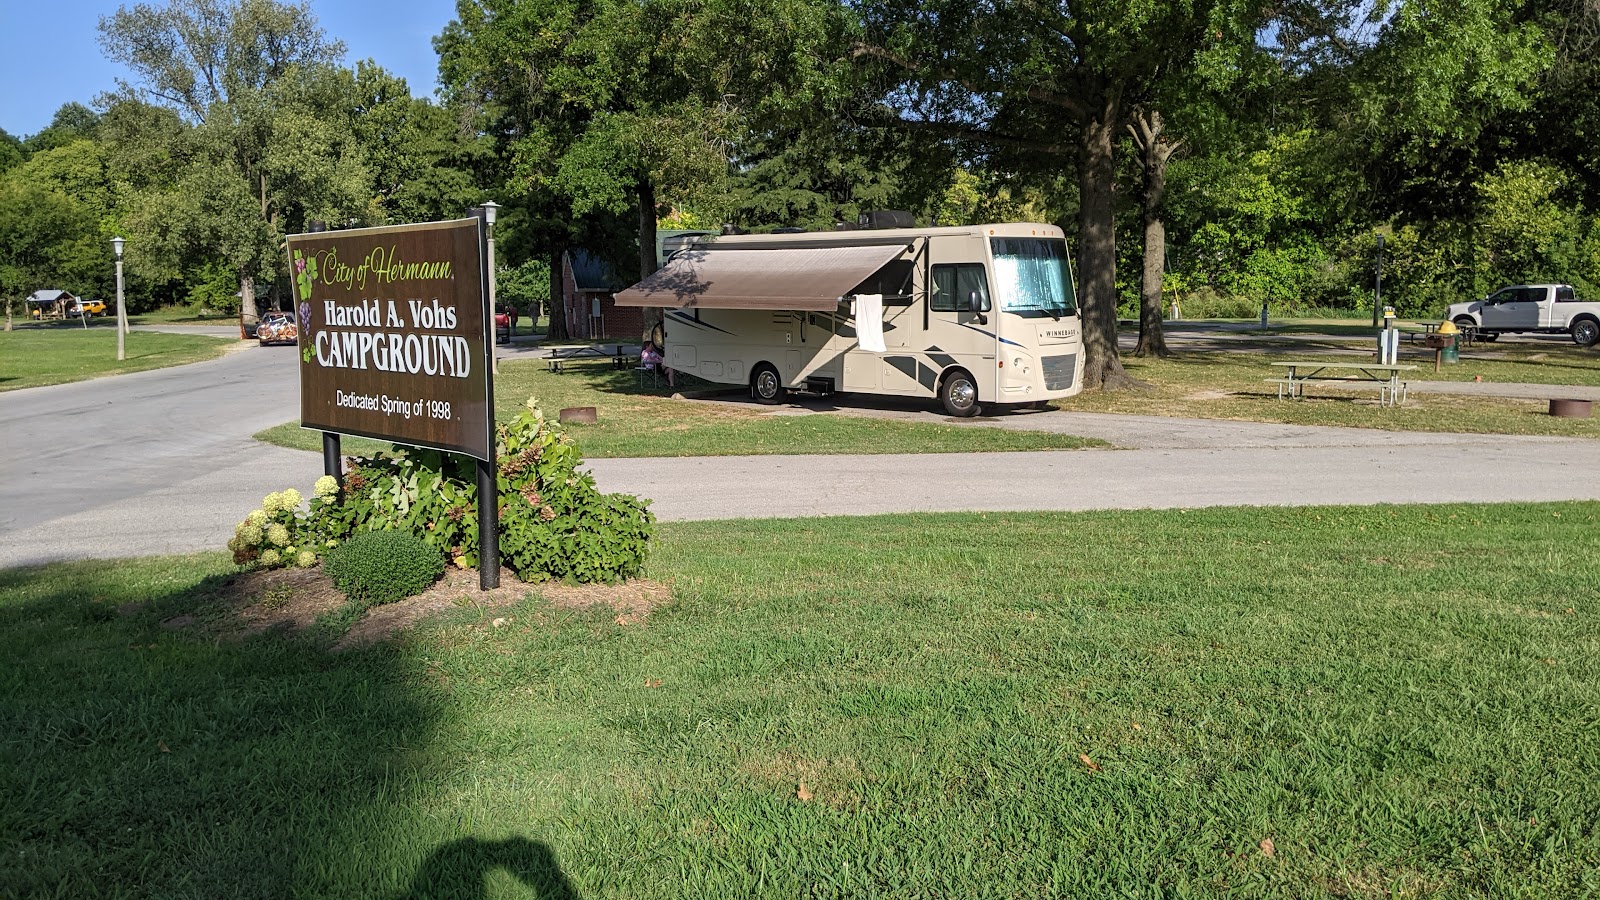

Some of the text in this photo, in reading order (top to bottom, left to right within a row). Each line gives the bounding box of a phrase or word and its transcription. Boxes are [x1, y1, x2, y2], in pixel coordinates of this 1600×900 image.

[323, 244, 452, 290] City of Hermann
[324, 299, 457, 329] Harold A. Vohs
[315, 330, 471, 378] CAMPGROUND
[336, 389, 451, 420] Dedicated Spring of 1998
